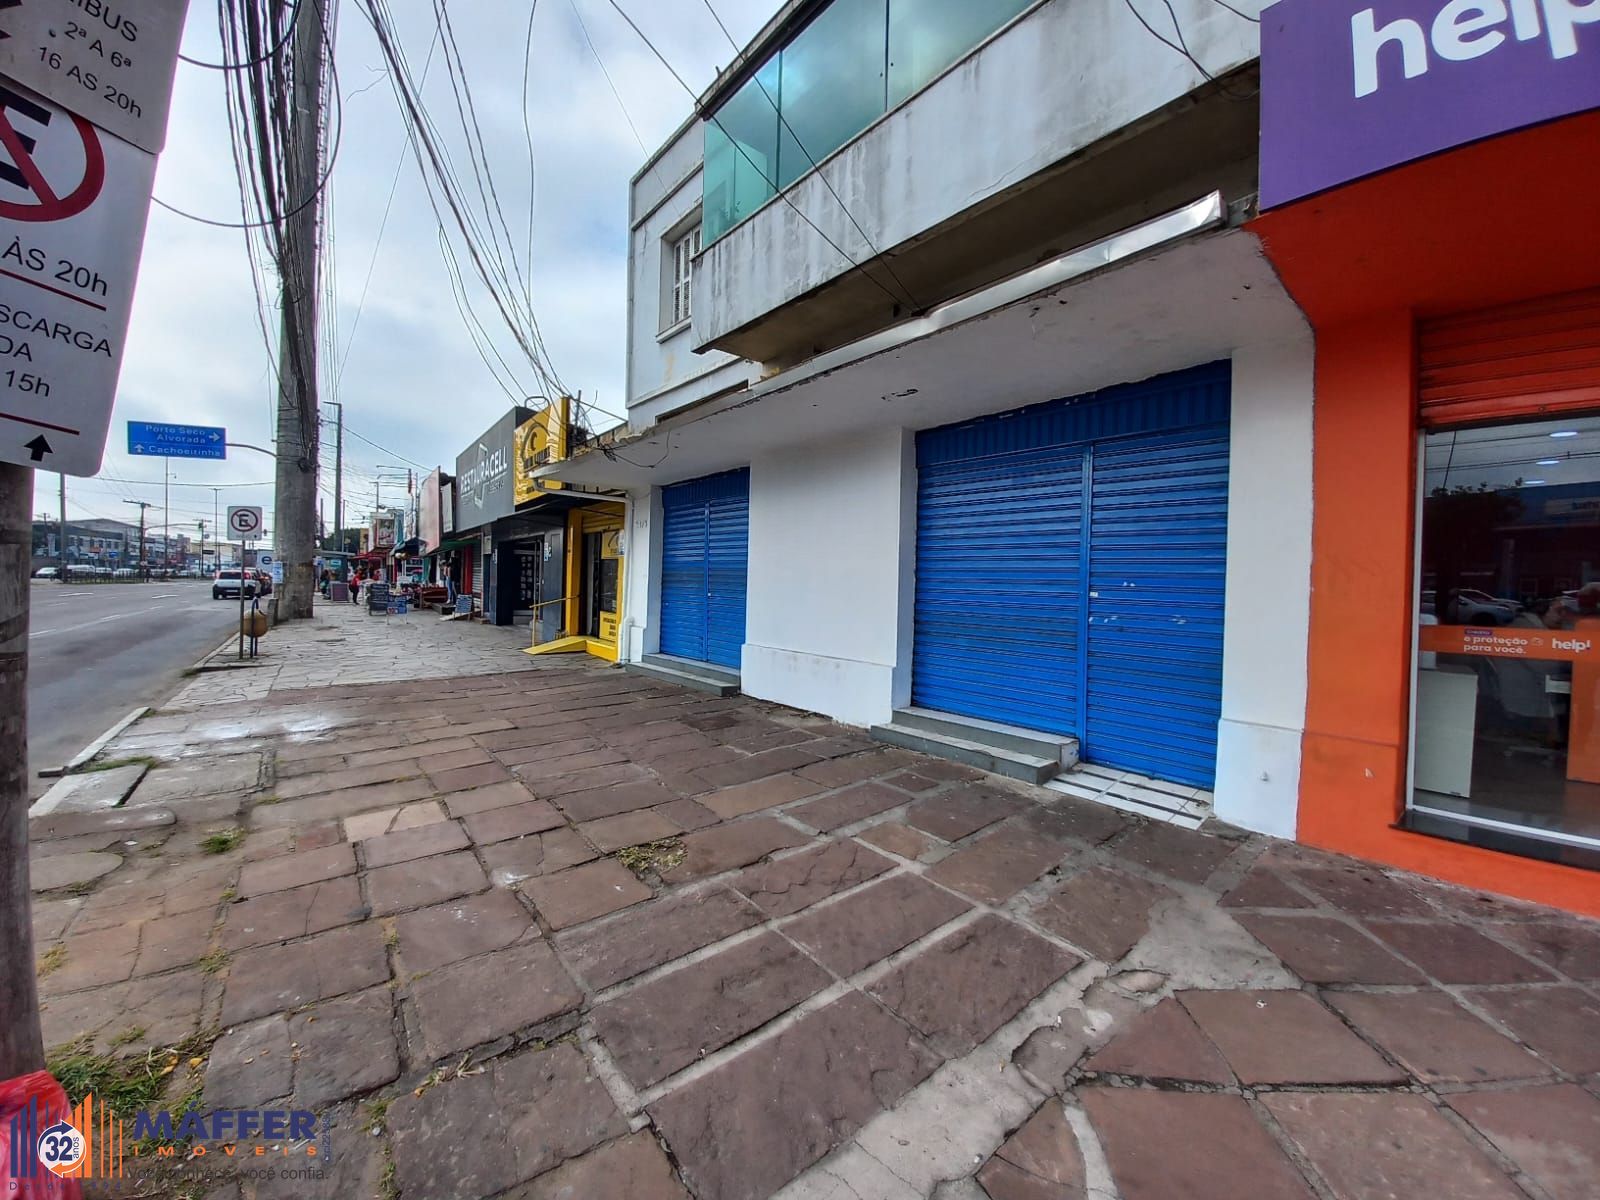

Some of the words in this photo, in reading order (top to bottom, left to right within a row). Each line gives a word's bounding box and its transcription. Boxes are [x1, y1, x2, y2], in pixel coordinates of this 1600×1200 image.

[39, 46, 62, 70] 16
[66, 65, 98, 92] AS
[103, 85, 142, 119] 20h
[2, 235, 46, 271] ÀS
[54, 259, 107, 297] 20h
[5, 369, 50, 397] 15h
[145, 424, 176, 434] Porto
[179, 426, 205, 436] Seco
[157, 433, 206, 444] Alvorada
[1552, 637, 1591, 653] help!
